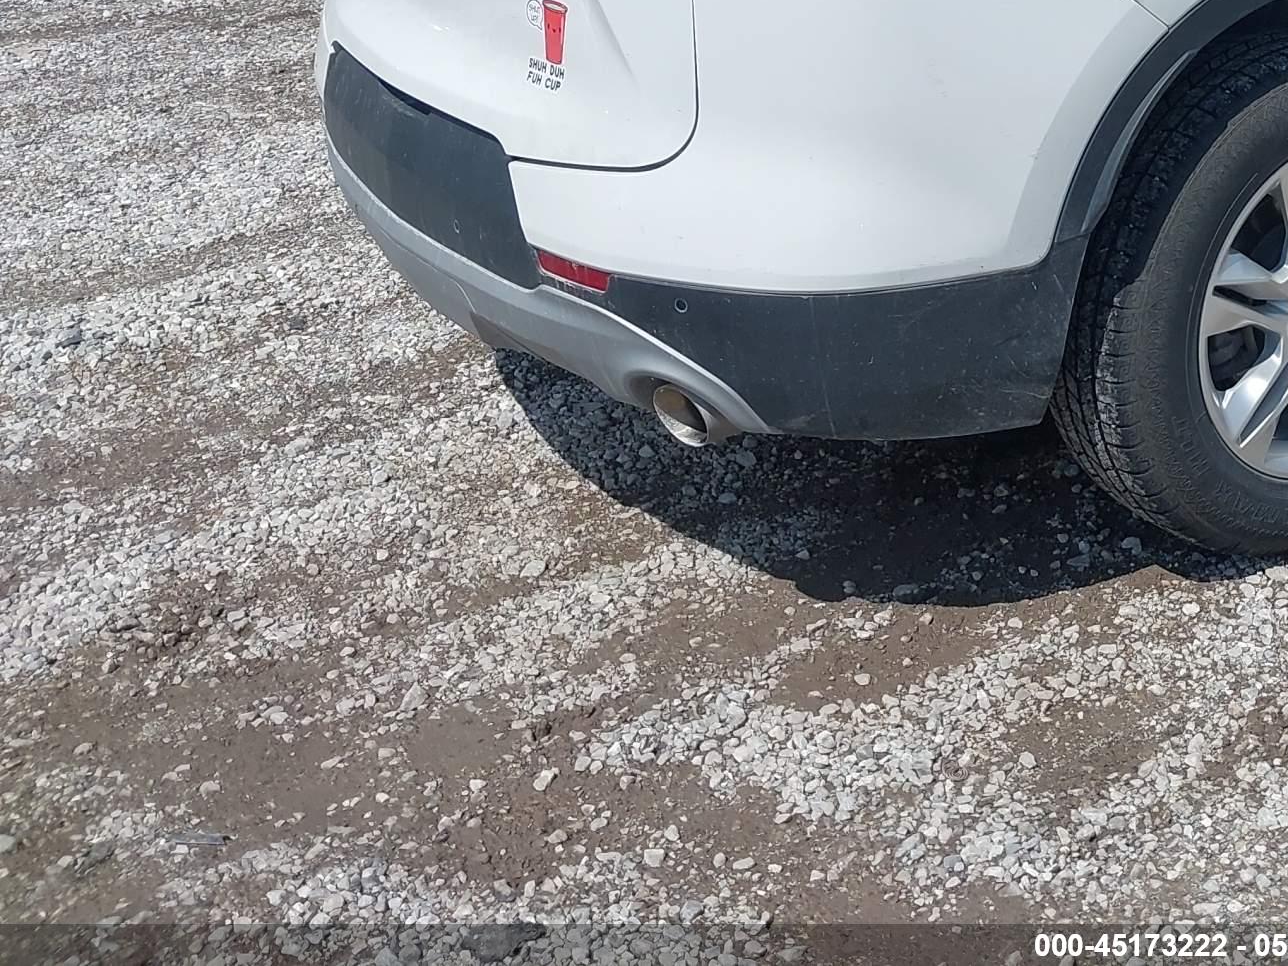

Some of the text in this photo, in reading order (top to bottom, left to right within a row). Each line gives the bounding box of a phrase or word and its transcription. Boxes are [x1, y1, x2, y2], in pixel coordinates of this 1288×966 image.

[529, 58, 565, 79] SHUH DUH
[527, 71, 561, 91] FUH CUP
